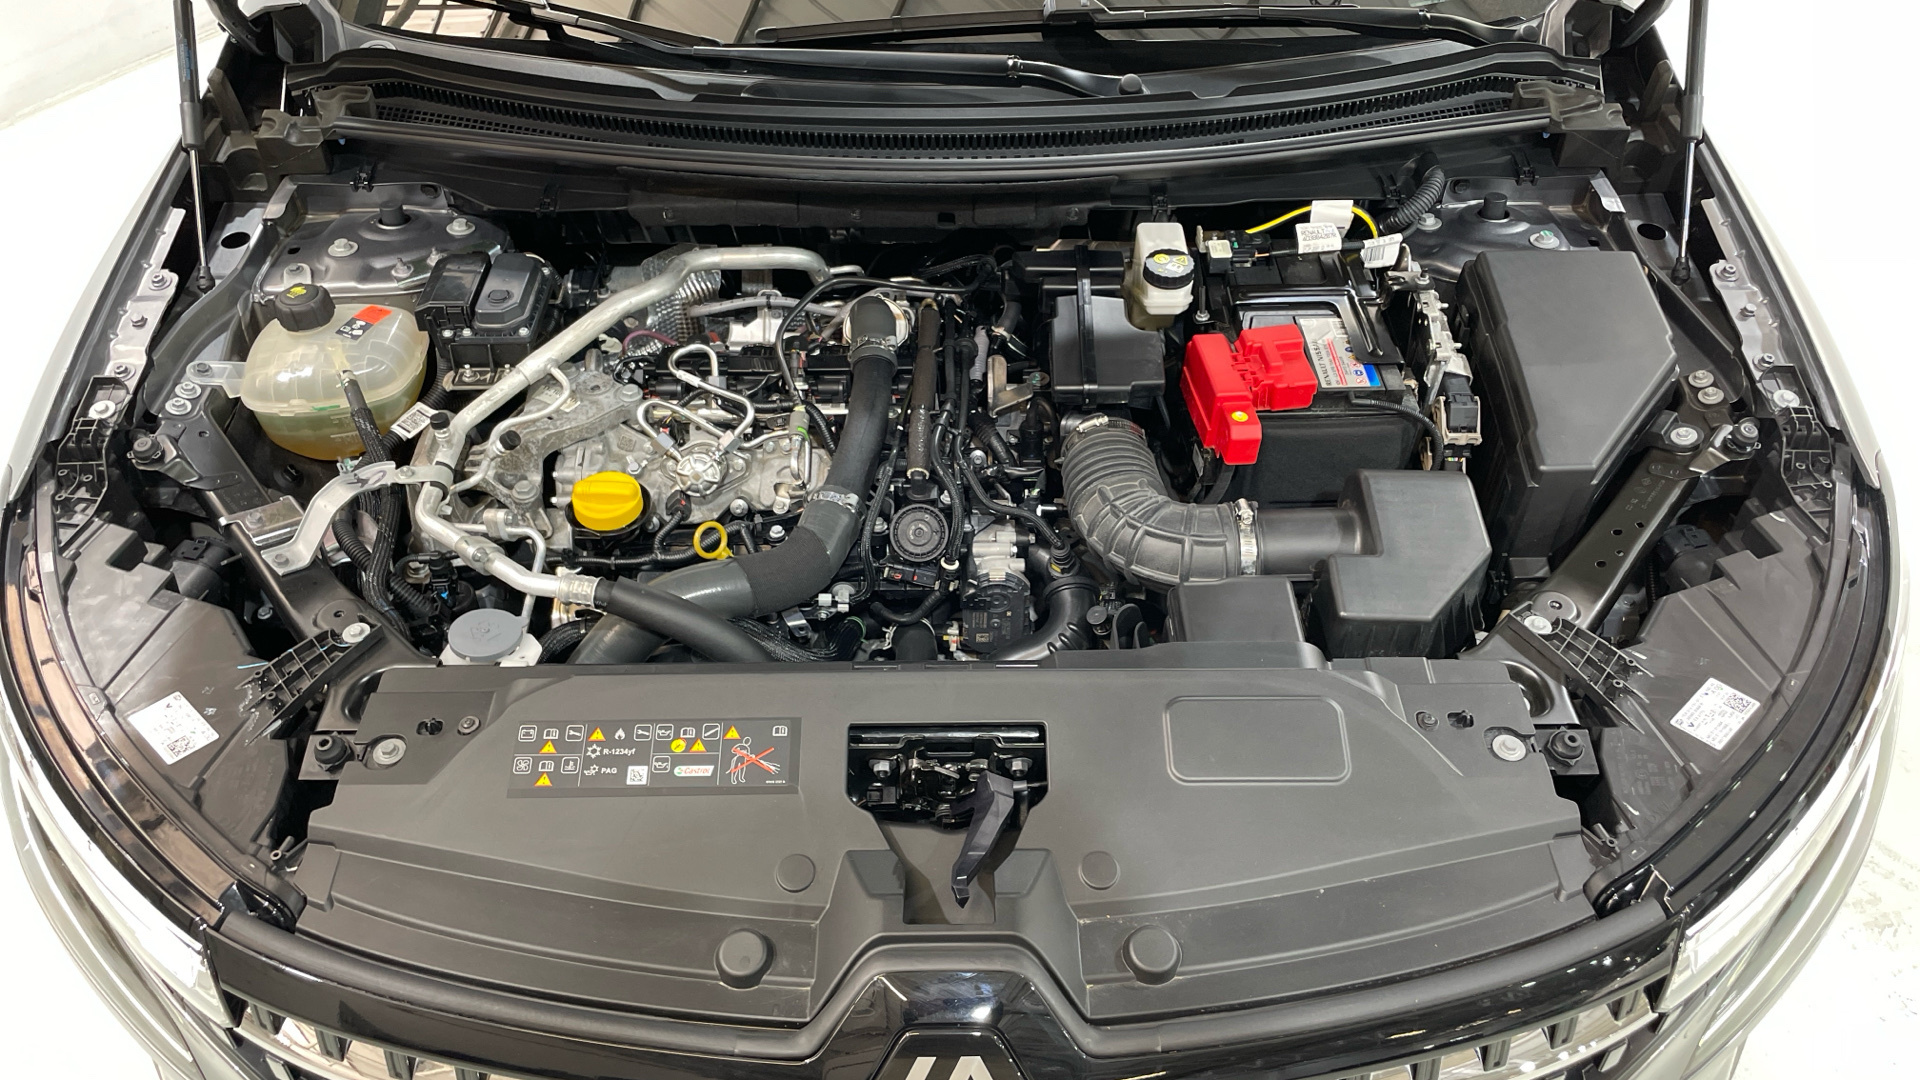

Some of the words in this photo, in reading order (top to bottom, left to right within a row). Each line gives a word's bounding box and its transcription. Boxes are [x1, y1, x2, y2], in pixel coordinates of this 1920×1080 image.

[1319, 363, 1332, 387] RENAULT
[603, 747, 636, 757] R-1234yf
[683, 766, 711, 775] Castrol
